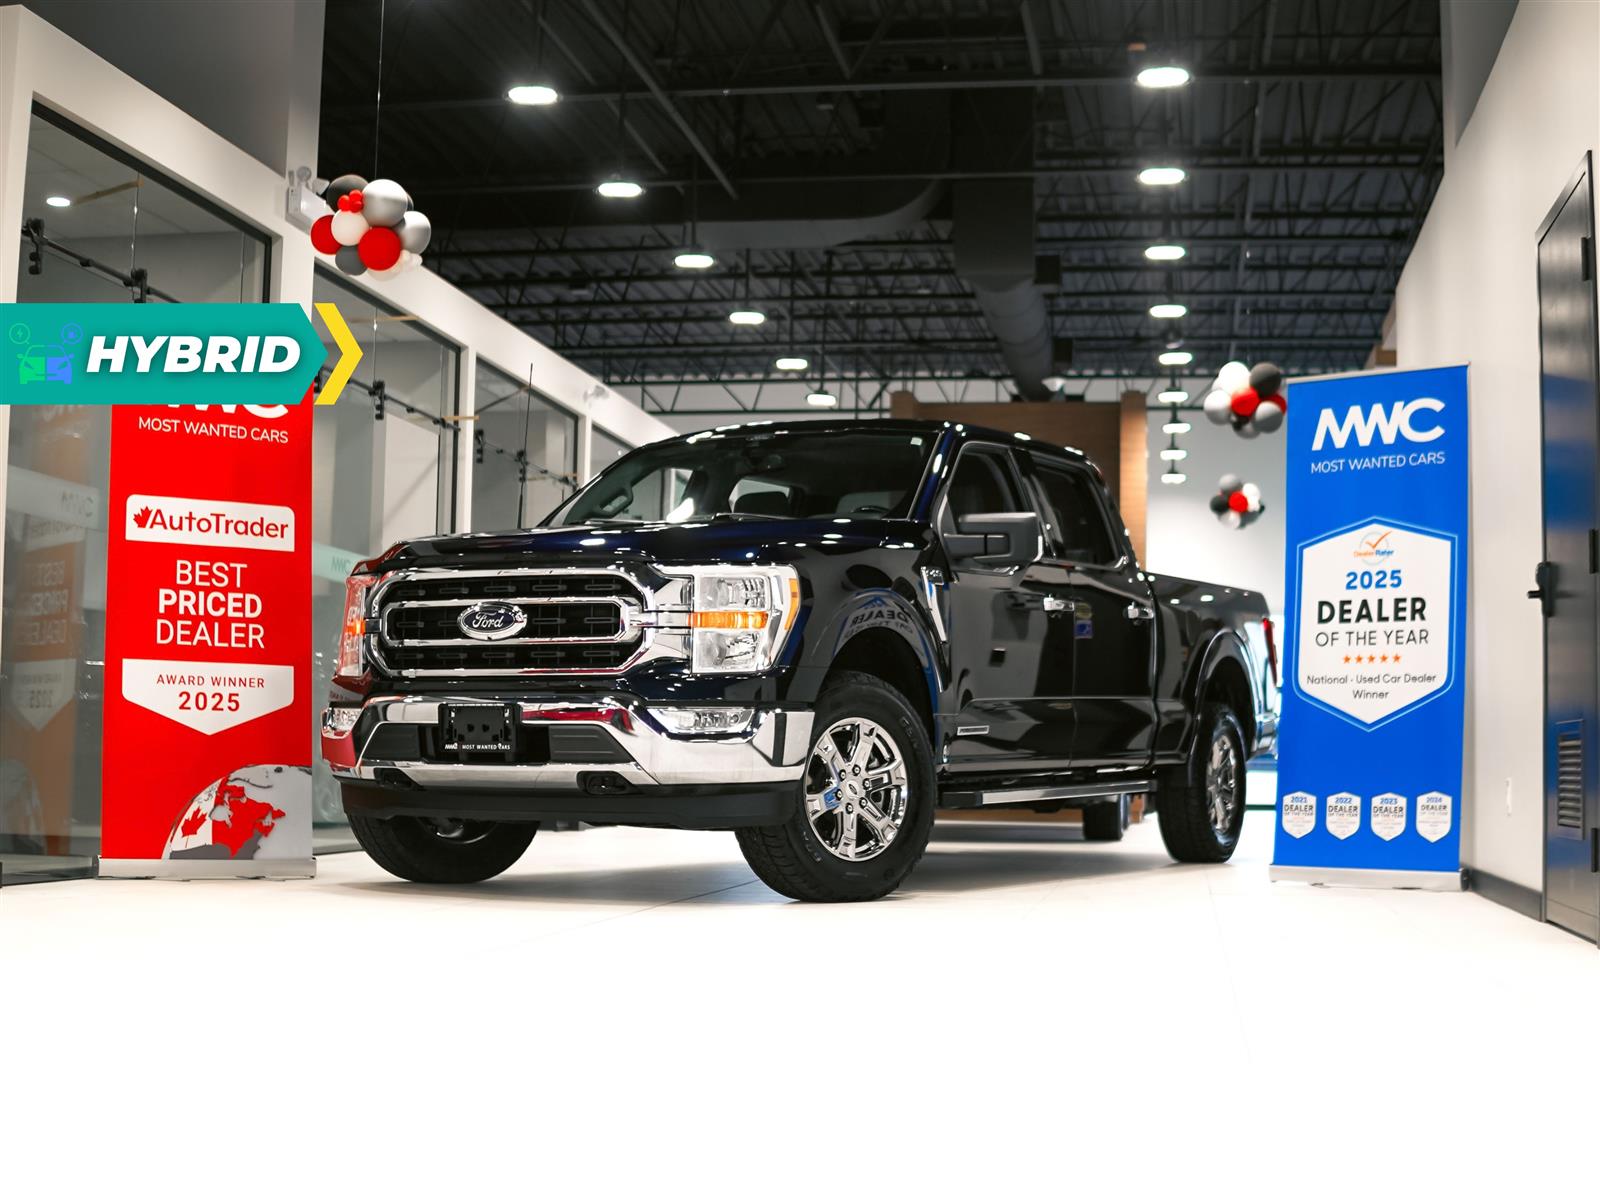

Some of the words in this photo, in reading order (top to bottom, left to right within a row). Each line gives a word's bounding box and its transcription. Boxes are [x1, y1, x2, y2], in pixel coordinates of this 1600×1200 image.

[138, 416, 179, 432] MOST
[181, 422, 247, 439] WANTED
[250, 427, 289, 444] CARS
[1312, 397, 1445, 451] MWC
[1311, 459, 1345, 474] MOST
[1348, 454, 1406, 470] WANTED
[1408, 451, 1446, 466] CARS
[149, 508, 288, 539] AutoTrader
[177, 559, 247, 588] BEST
[1345, 570, 1402, 590] 2025
[158, 589, 262, 618] PRICED
[1317, 597, 1426, 625] DEALER
[471, 611, 503, 629] Ford
[156, 620, 265, 649] DEALER
[1315, 632, 1339, 647] OF
[1346, 631, 1376, 646] THE
[1384, 629, 1429, 645] YEAR
[156, 674, 204, 686] AWARD
[211, 676, 265, 689] WINNER
[1307, 675, 1347, 685] National
[1356, 675, 1380, 684] Used
[1383, 674, 1400, 683] Car
[1404, 673, 1436, 683] Dealer
[178, 691, 240, 712] 2025
[1352, 689, 1389, 699] Winner
[1284, 804, 1313, 812] DEALER
[1328, 805, 1358, 813] DEALER
[1373, 806, 1403, 814] DEALER
